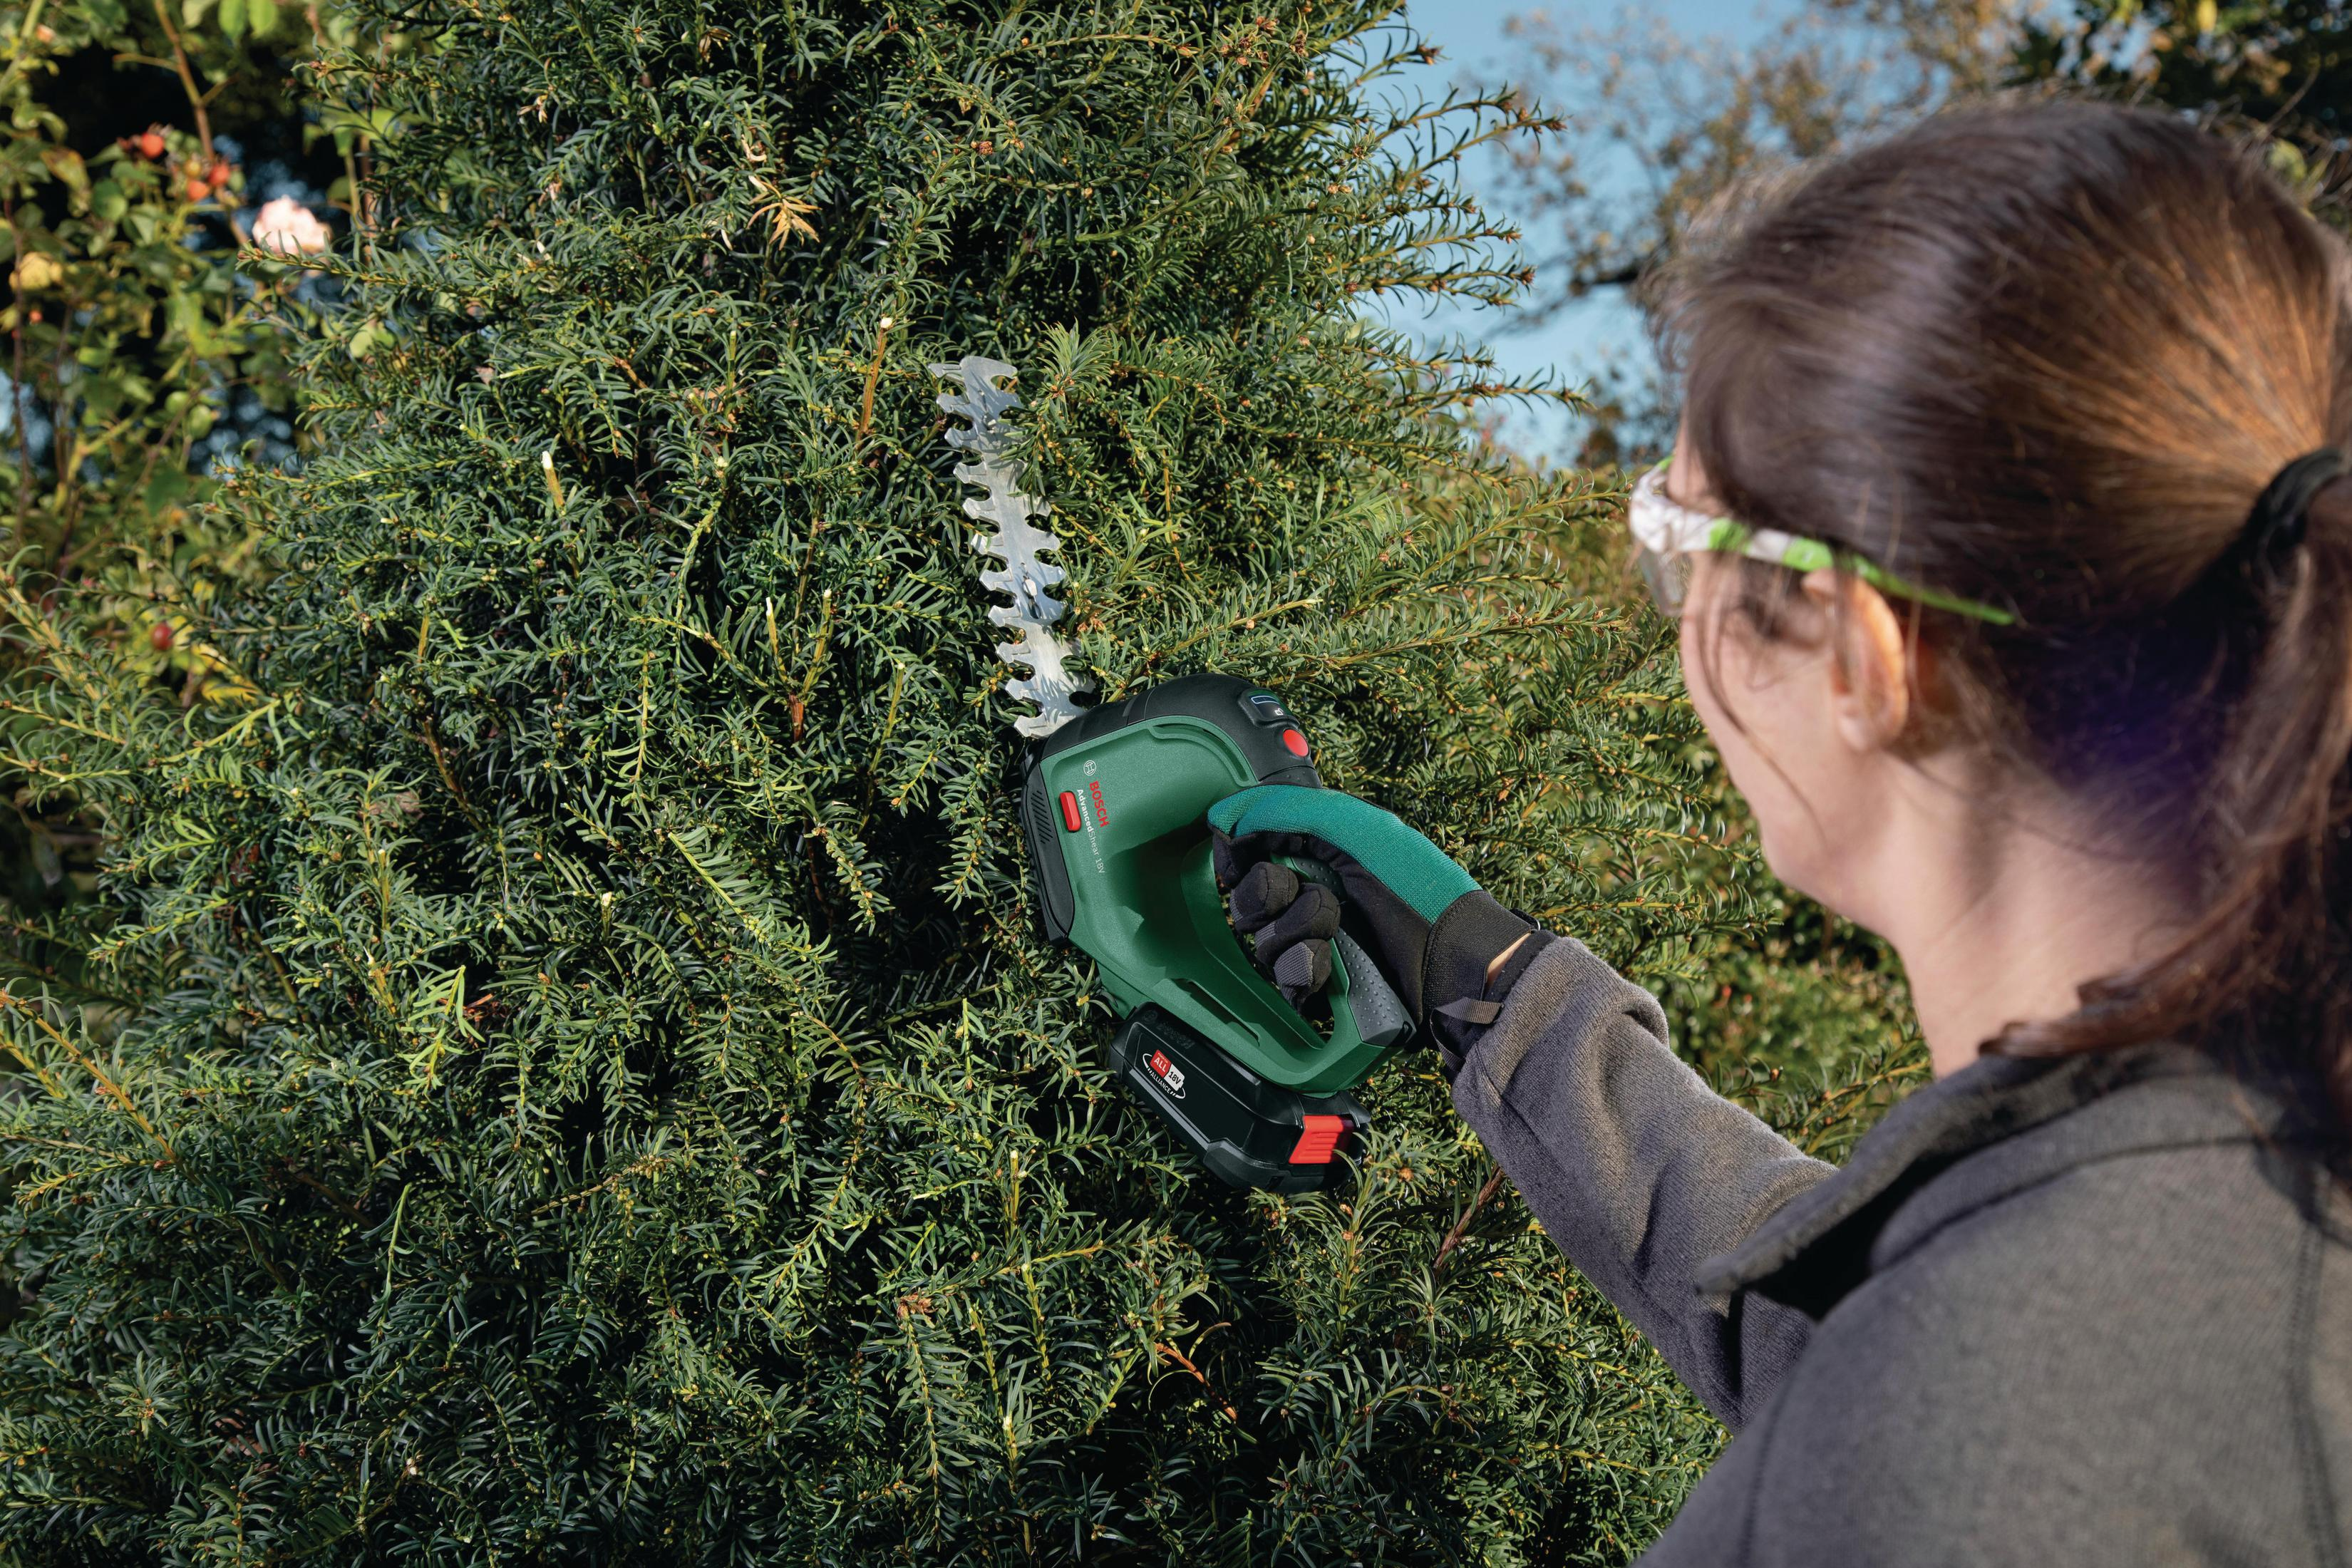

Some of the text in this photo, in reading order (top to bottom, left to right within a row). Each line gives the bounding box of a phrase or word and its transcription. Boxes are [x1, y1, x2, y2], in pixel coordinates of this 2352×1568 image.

[1089, 780, 1110, 827] BOSCH
[1077, 789, 1105, 873] AdvancedShear 18V
[1154, 1057, 1167, 1072] ALL
[1150, 1072, 1171, 1093] ALLIANCE
[1169, 1071, 1181, 1084] 18V
